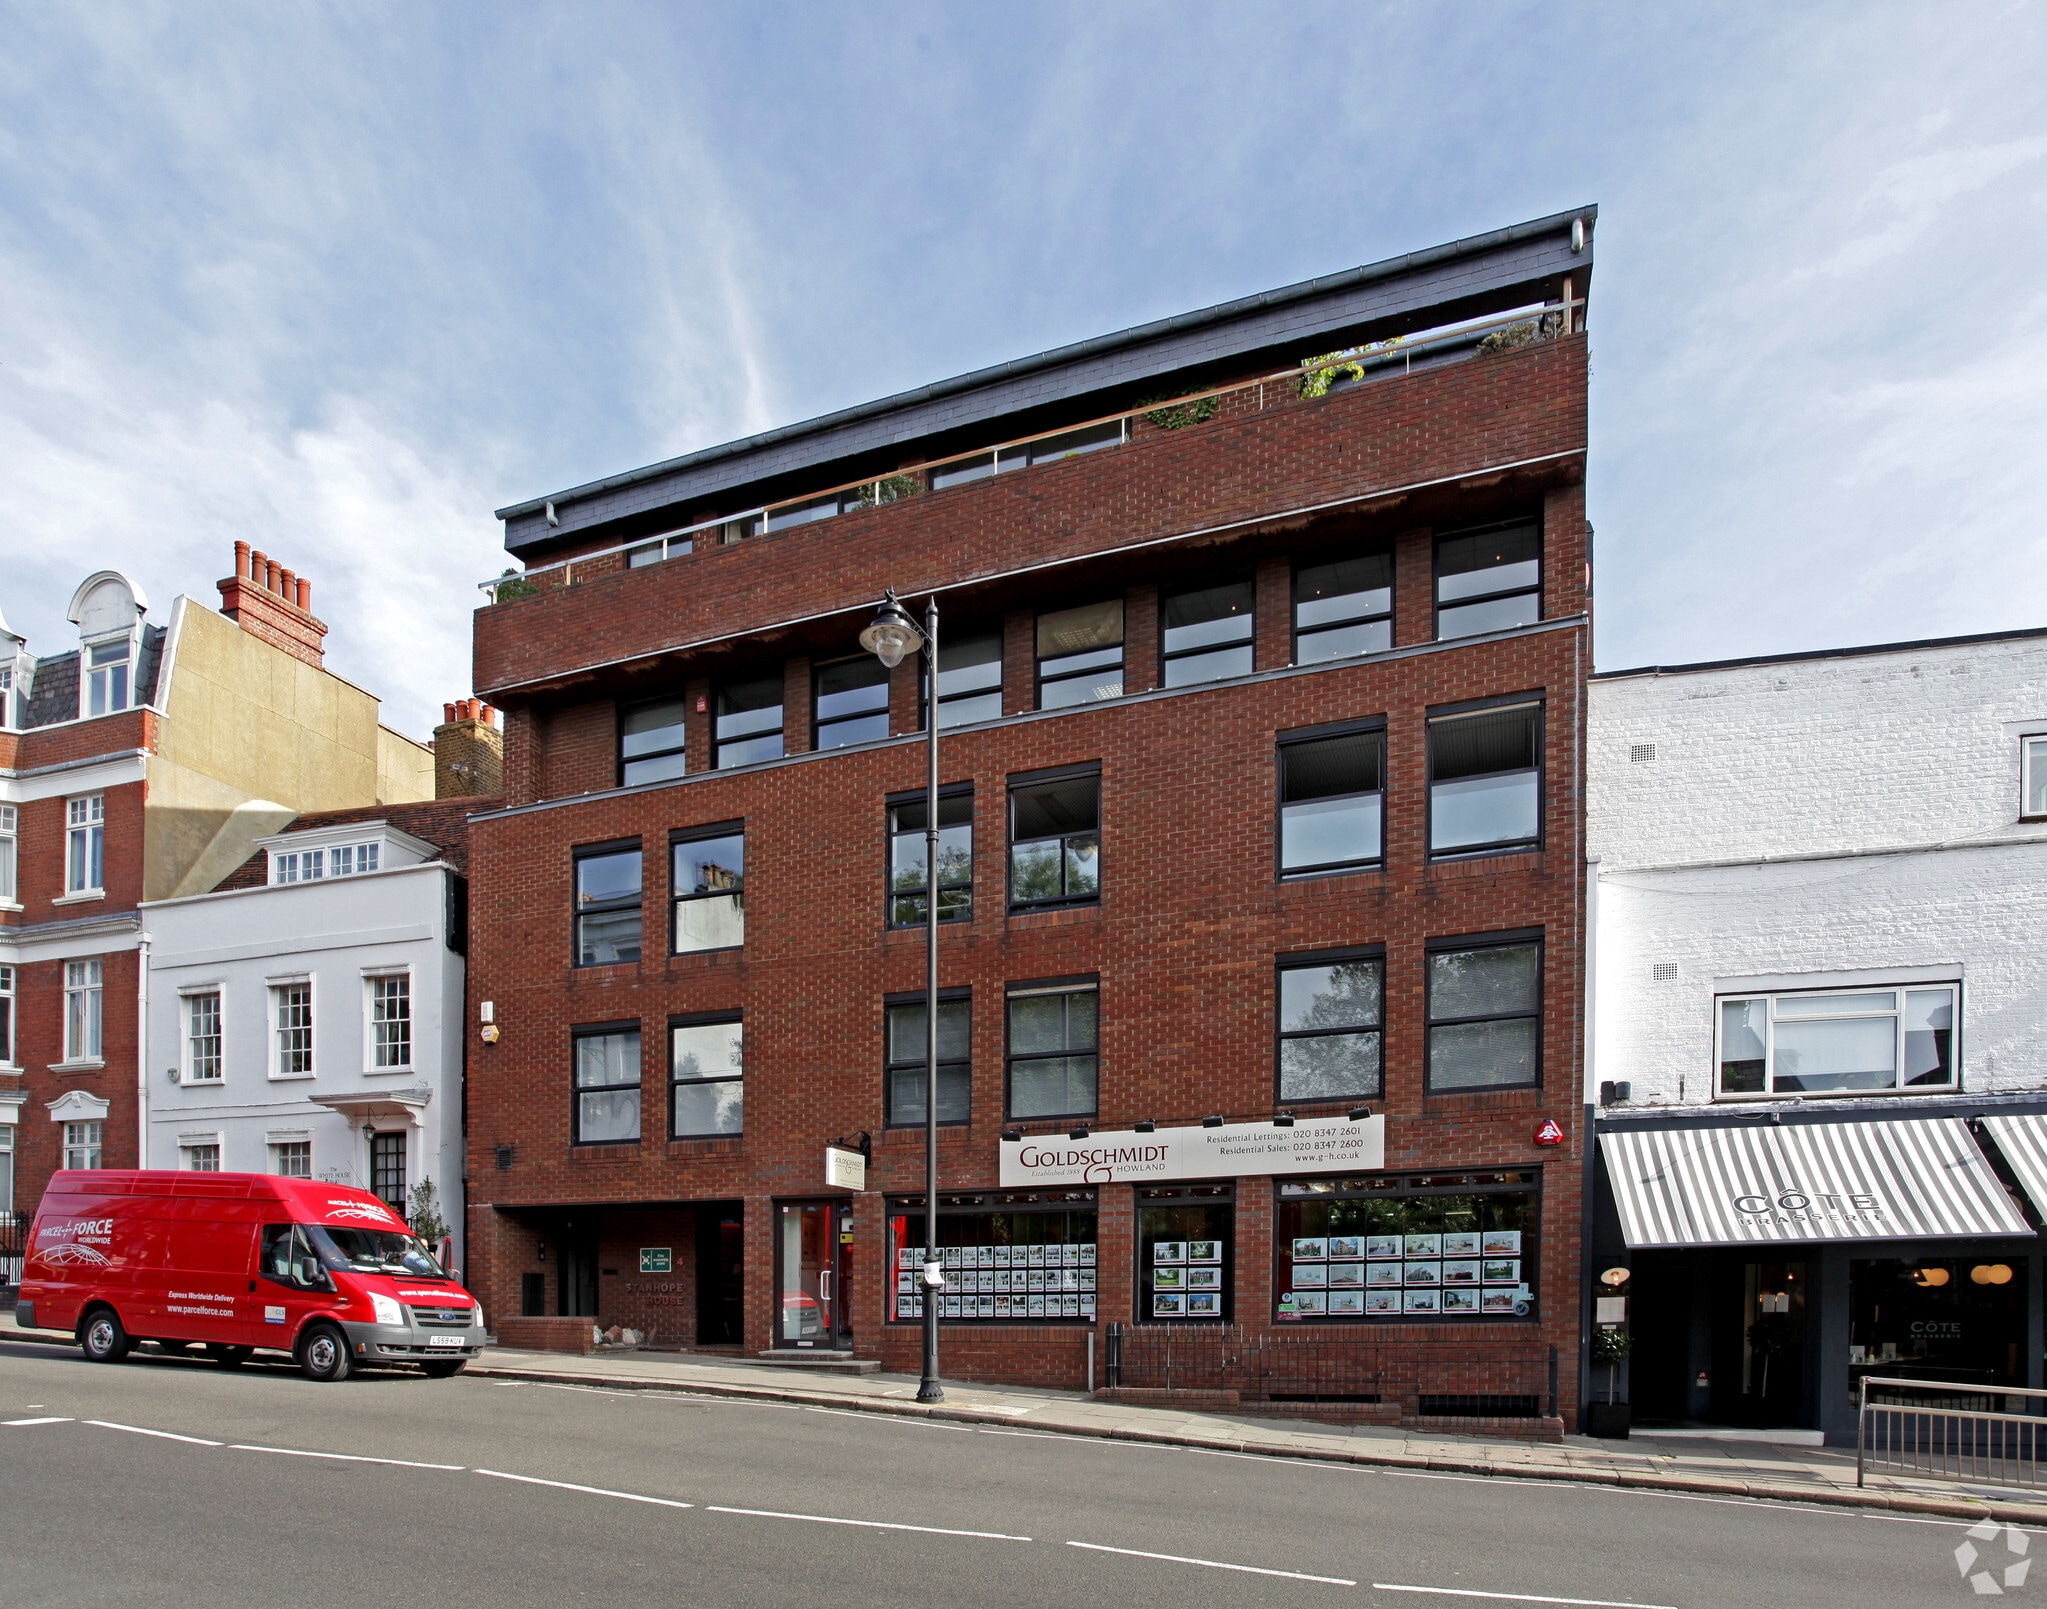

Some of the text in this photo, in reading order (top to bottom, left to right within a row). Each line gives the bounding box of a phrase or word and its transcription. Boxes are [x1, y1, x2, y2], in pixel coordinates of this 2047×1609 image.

[1207, 1127, 1361, 1143] Residential Lettings: 020 8347 2601
[1220, 1139, 1363, 1155] Residential Sales: 020 8347 2600
[1020, 1146, 1169, 1168] GOLDSCHMIDT
[1295, 1151, 1360, 1162] www.g-h.co.uk
[1031, 1169, 1065, 1177] Established
[1116, 1163, 1166, 1173] HOWLAND
[1733, 1188, 1880, 1214] CÔTE
[1739, 1213, 1887, 1226] BRASSERIE
[72, 1219, 113, 1235] FORCE
[625, 1283, 683, 1292] STANHOPE
[168, 1291, 235, 1304] Express Worldwide Delivery
[649, 1296, 683, 1305] HOUSE
[167, 1305, 234, 1317] www.parcelforce.com
[1911, 1320, 1961, 1332] CÔTE
